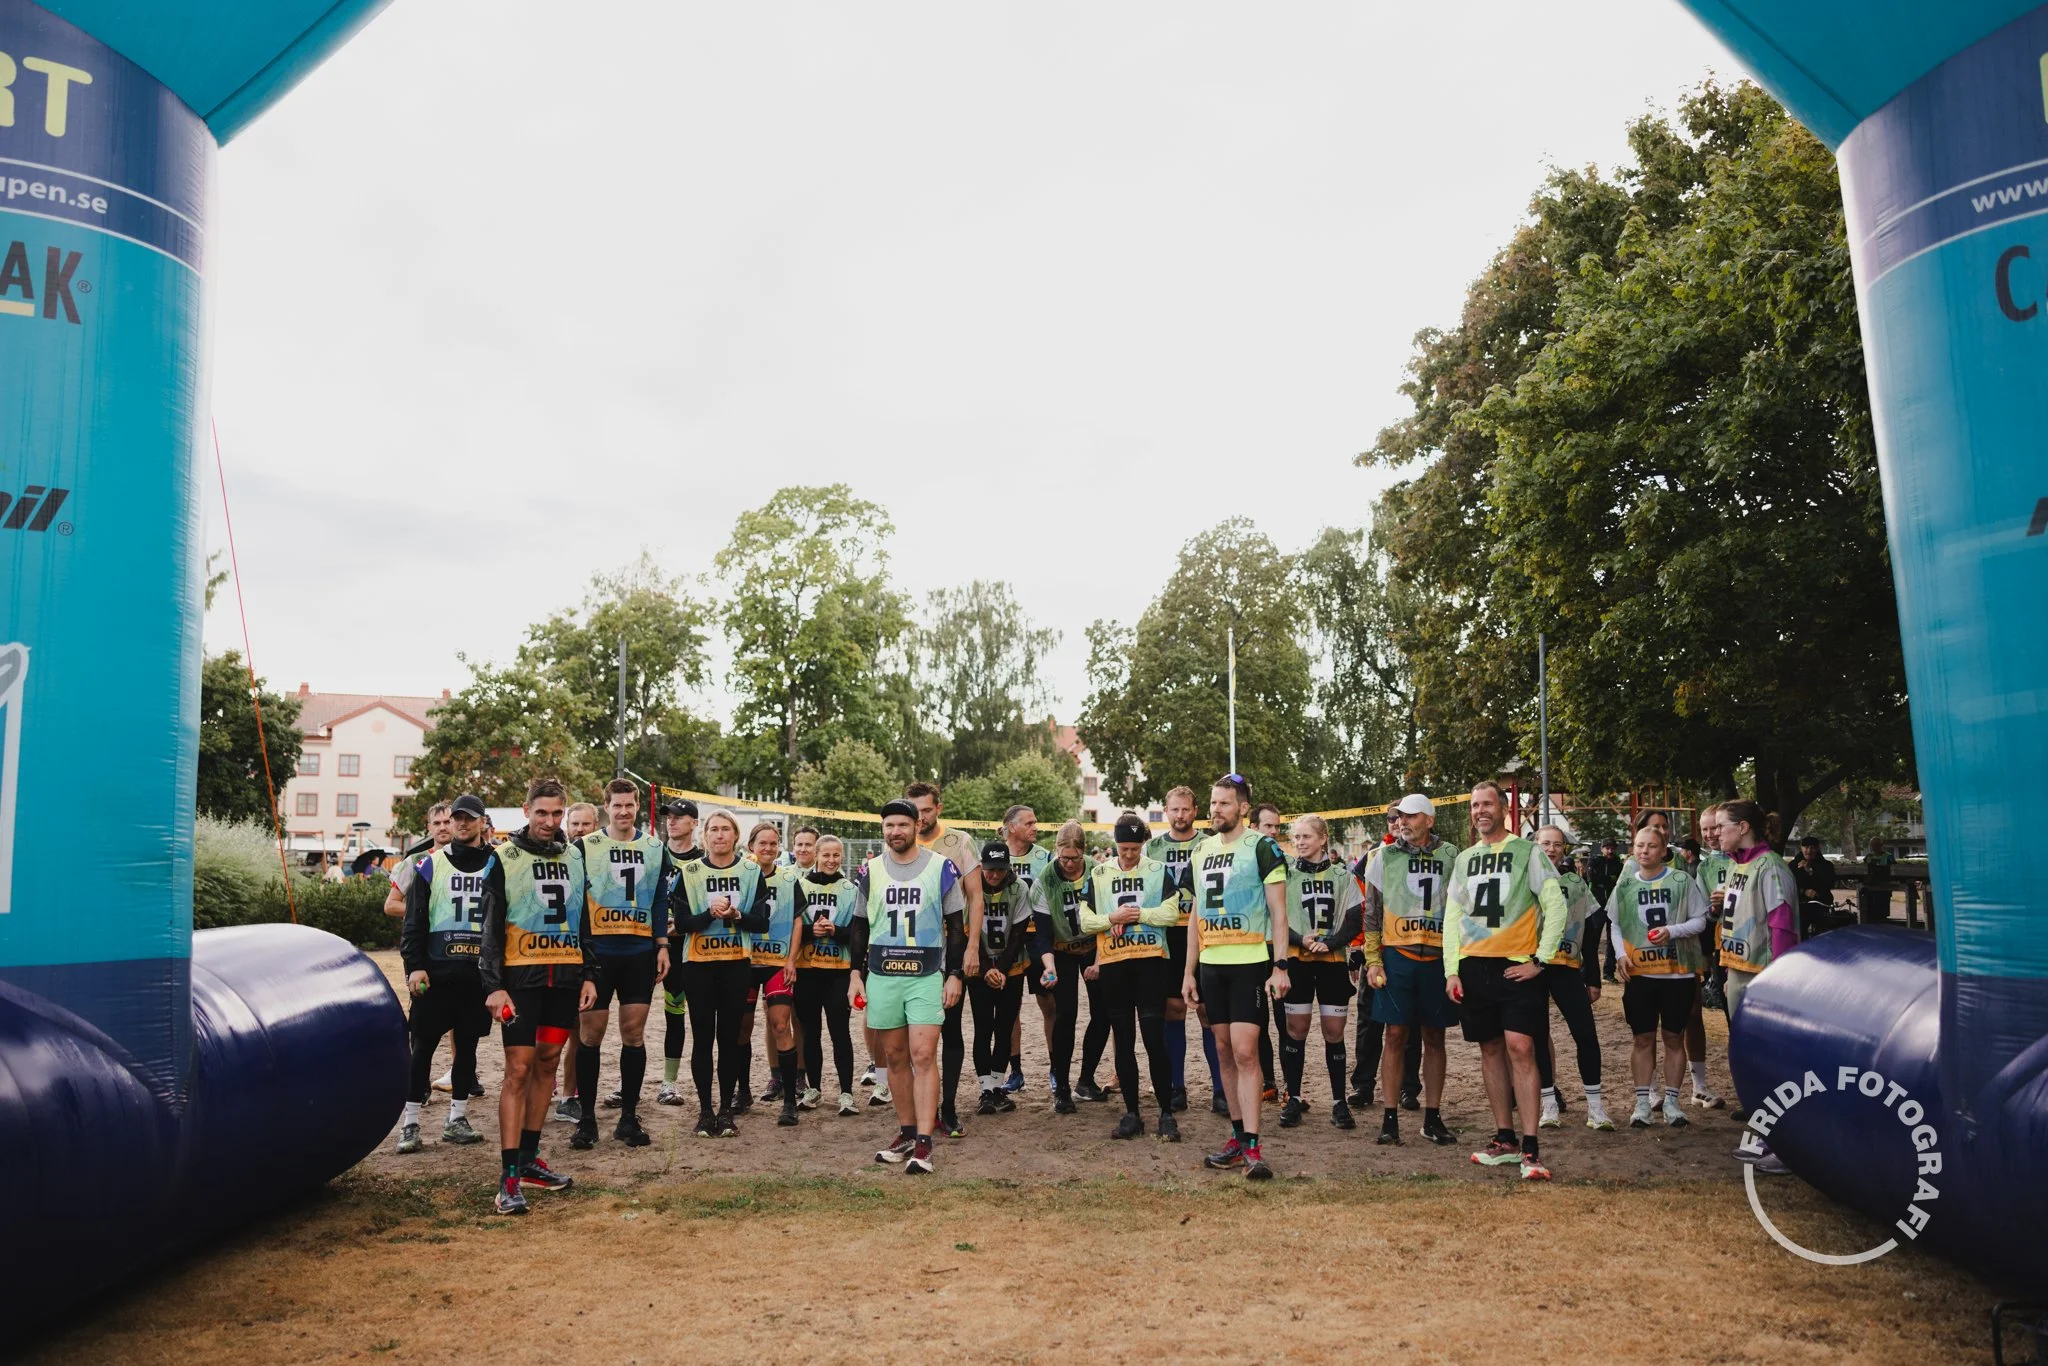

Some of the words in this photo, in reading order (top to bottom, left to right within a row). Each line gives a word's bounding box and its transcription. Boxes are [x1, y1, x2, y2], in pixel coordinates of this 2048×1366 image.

[0, 176, 108, 214] pen.se
[609, 846, 644, 864] ÖAR
[1203, 853, 1234, 871] ÖAR
[1408, 855, 1443, 875] ÖAR
[1467, 852, 1513, 877] ÖAR
[532, 859, 569, 880] ÖAR
[620, 867, 635, 901] 1
[706, 875, 740, 892] ÖAR
[1112, 876, 1144, 894] ÖAR
[1206, 872, 1224, 909] 2
[1302, 878, 1334, 895] ÖAR
[542, 884, 567, 924] 3
[807, 890, 837, 906] ÖAR
[886, 884, 921, 905] ÖAR
[1418, 877, 1433, 911] 1
[1469, 878, 1504, 928] 4
[1638, 888, 1671, 905] ÖAR
[451, 896, 482, 922] 12
[1302, 897, 1336, 929] 13
[1723, 893, 1737, 931] 2
[887, 909, 916, 938] 11
[701, 937, 743, 950] JOKA
[987, 920, 1006, 949] 6
[1109, 934, 1157, 950] JOKAB
[450, 945, 480, 954] JOKAB
[752, 942, 782, 954] KAB
[1722, 940, 1744, 956] KAB
[886, 961, 918, 971] JOKAB
